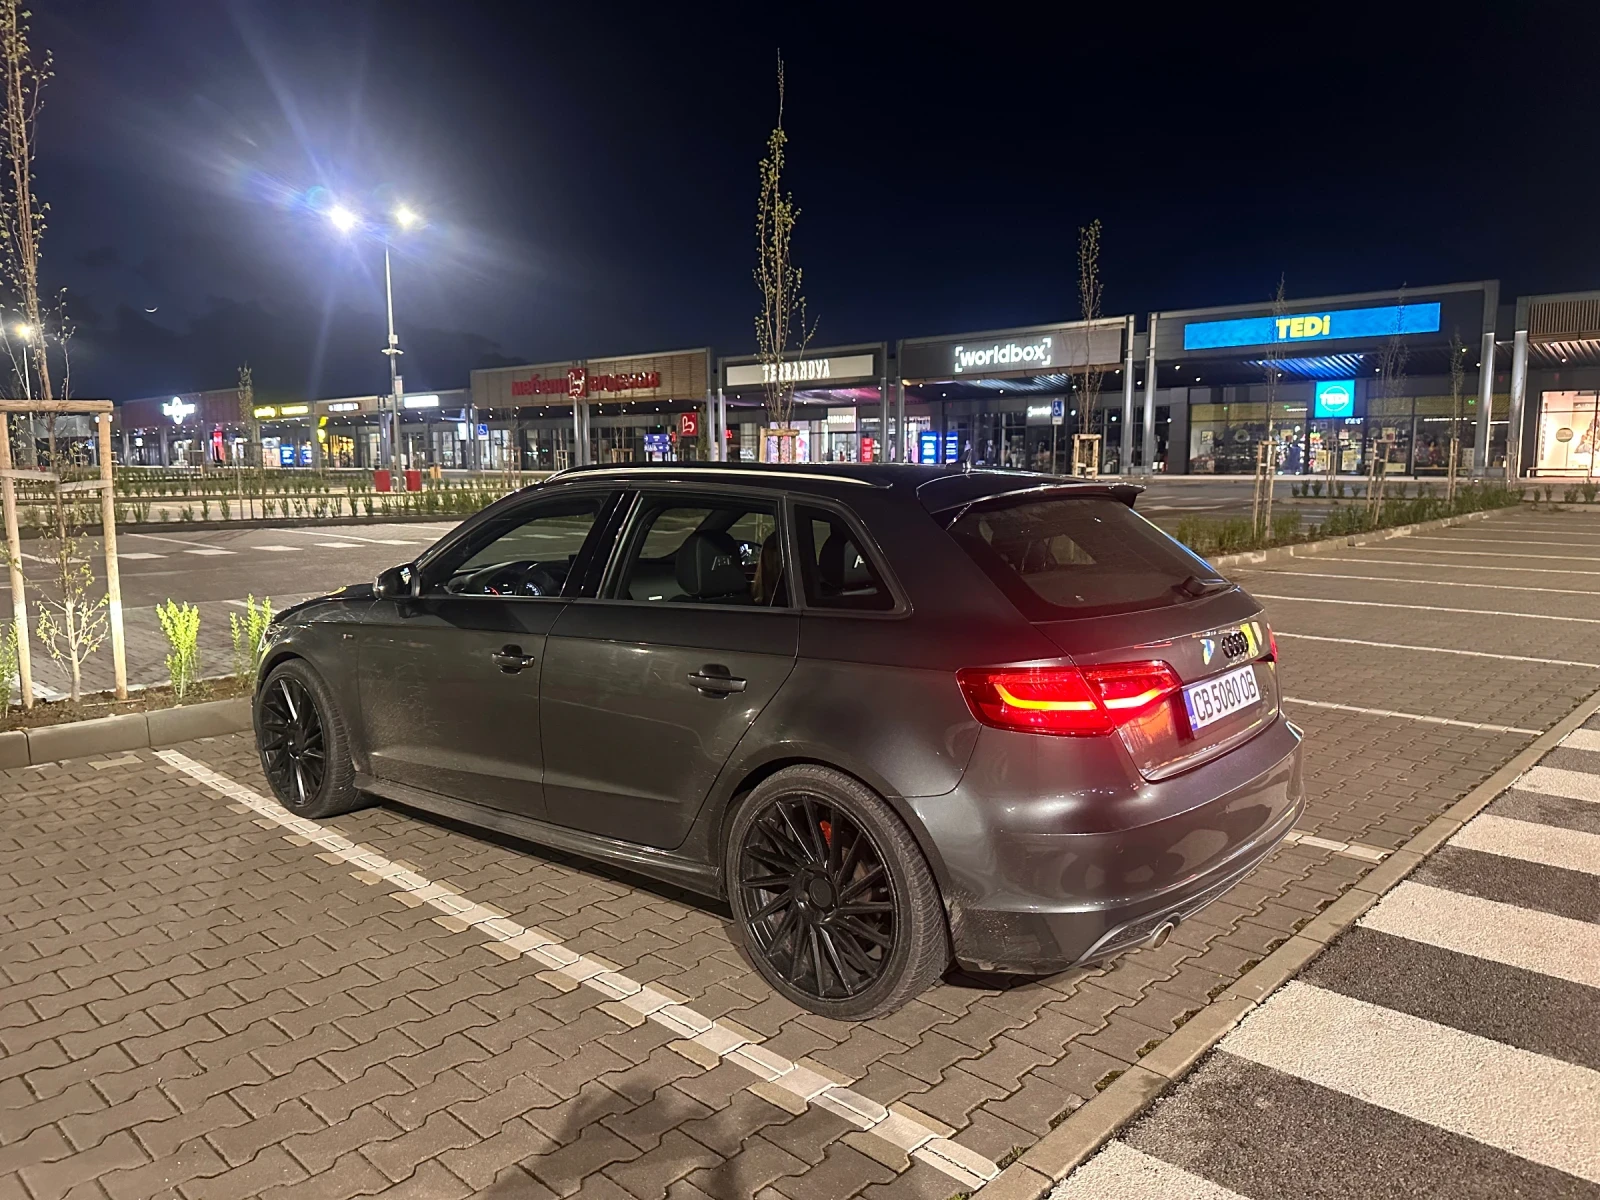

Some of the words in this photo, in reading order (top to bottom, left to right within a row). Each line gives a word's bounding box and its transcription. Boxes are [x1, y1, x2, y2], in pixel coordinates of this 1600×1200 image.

[1276, 315, 1330, 339] TEDi
[959, 343, 1046, 367] worldbox
[511, 373, 569, 396] мебели
[1193, 688, 1213, 721] CB
[1211, 676, 1241, 713] 5080
